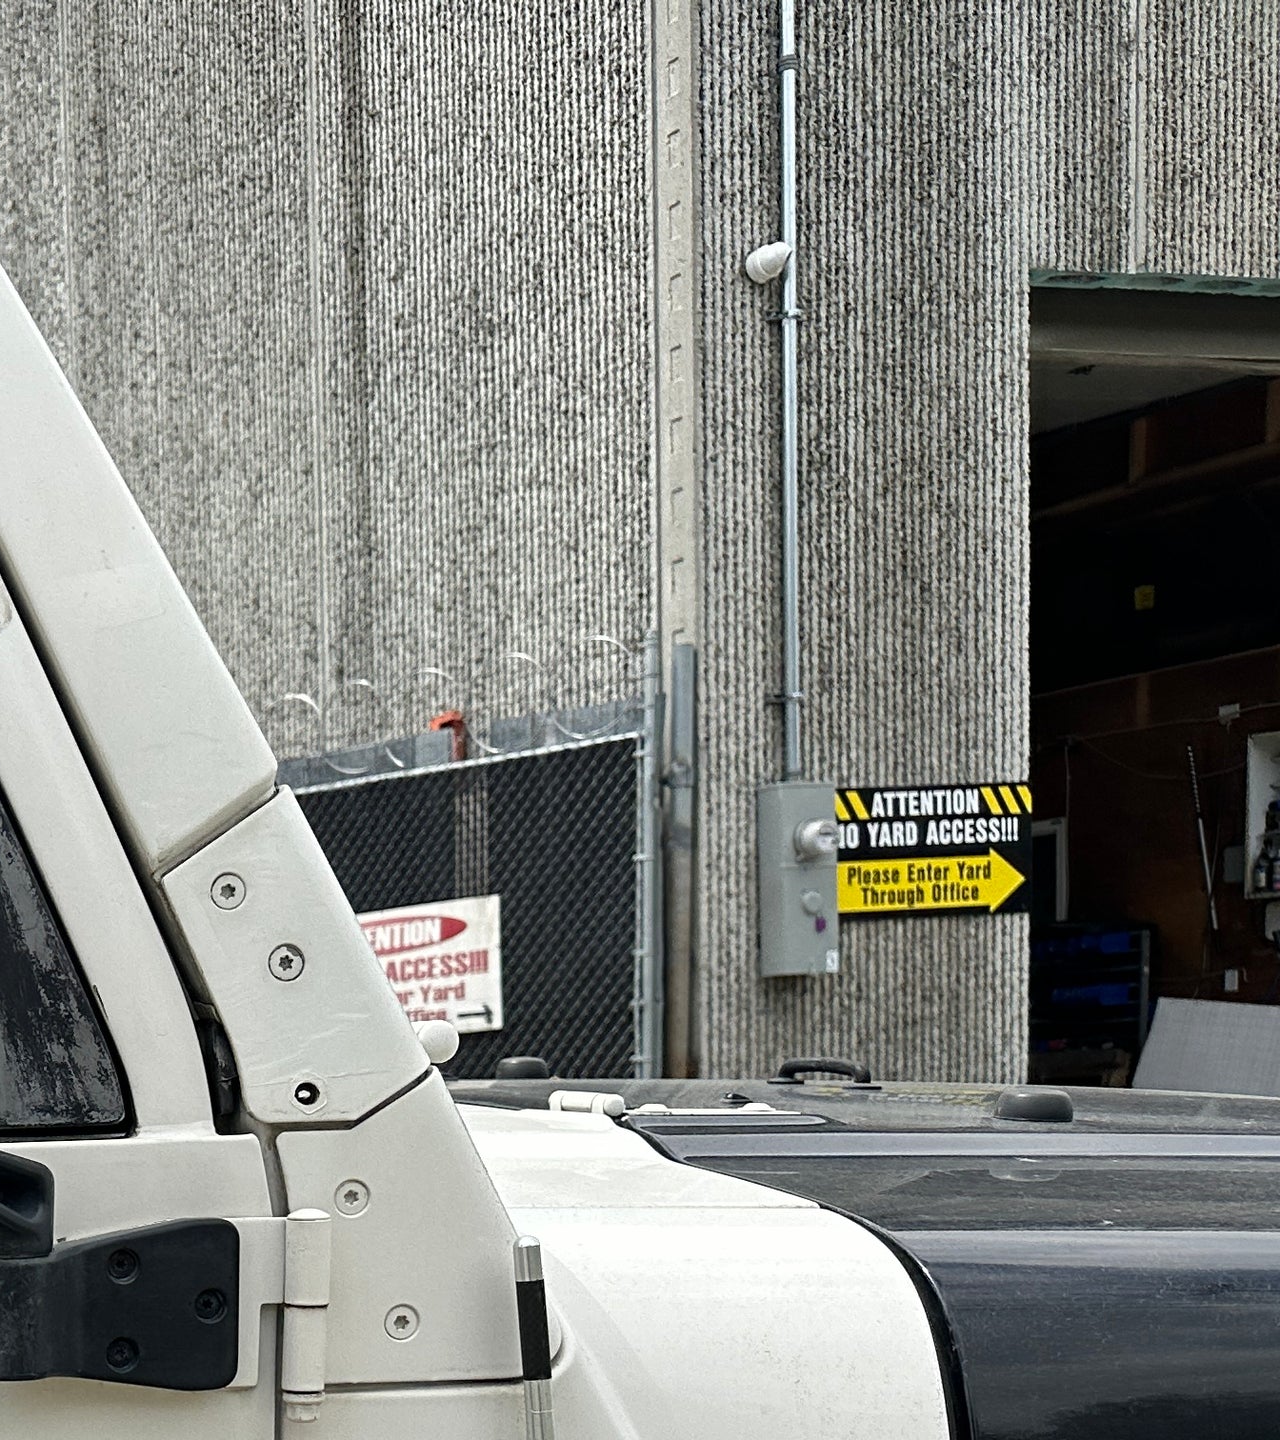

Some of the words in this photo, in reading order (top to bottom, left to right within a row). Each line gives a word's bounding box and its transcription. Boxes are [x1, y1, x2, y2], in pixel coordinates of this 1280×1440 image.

[871, 789, 979, 817] ATTENTION
[867, 820, 918, 848] YARD
[926, 817, 1019, 845] ACCESS!!!
[847, 865, 901, 885] Please
[907, 863, 950, 881] Enter
[956, 860, 992, 879] Yard
[861, 886, 925, 907] Through
[932, 885, 979, 900] Office
[364, 919, 440, 949] ENTION
[386, 950, 488, 983] ACCESS!!!
[420, 982, 466, 1004] Yard
